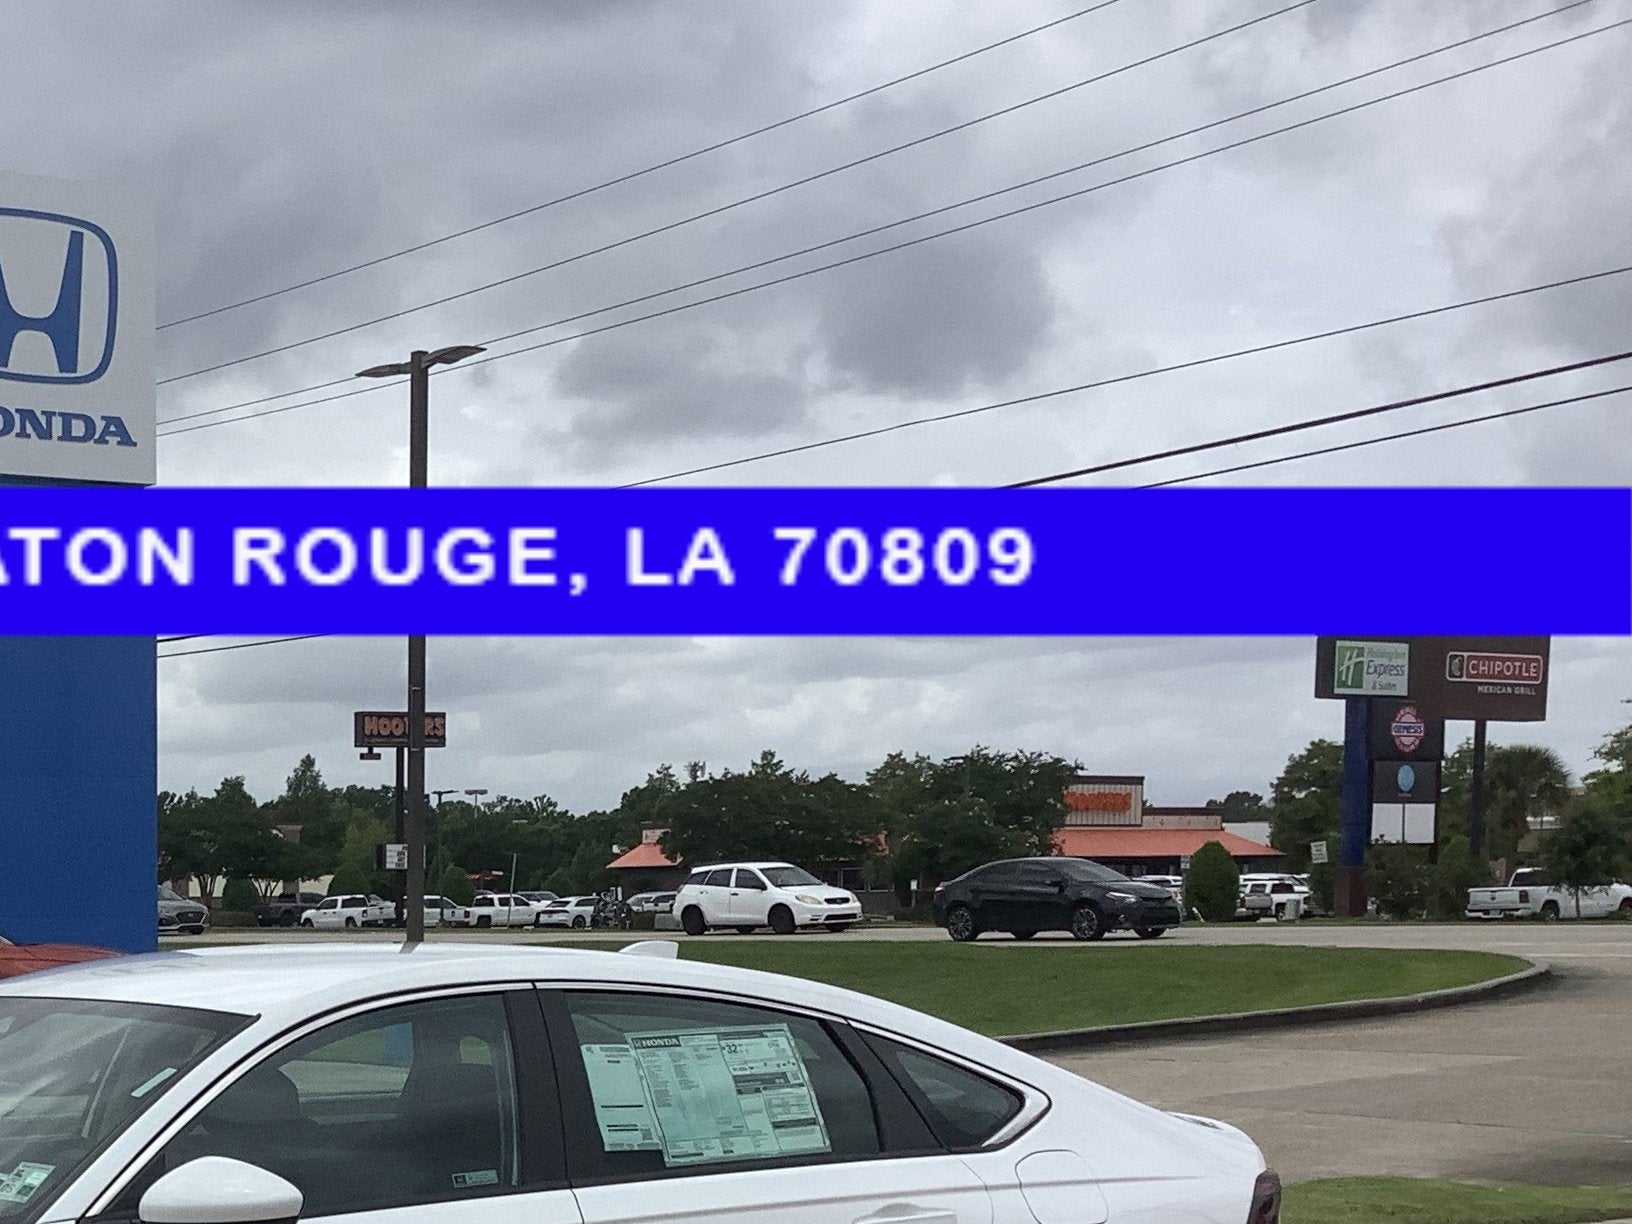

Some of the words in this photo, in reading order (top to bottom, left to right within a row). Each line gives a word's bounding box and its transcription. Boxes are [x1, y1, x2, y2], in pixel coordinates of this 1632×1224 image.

[1366, 660, 1405, 679] Express
[1469, 660, 1538, 676] CHIPOTLE
[1477, 685, 1512, 694] MEXICAN
[1514, 686, 1536, 696] GRILL
[364, 716, 445, 736] HOORS
[642, 1038, 680, 1048] HONDA
